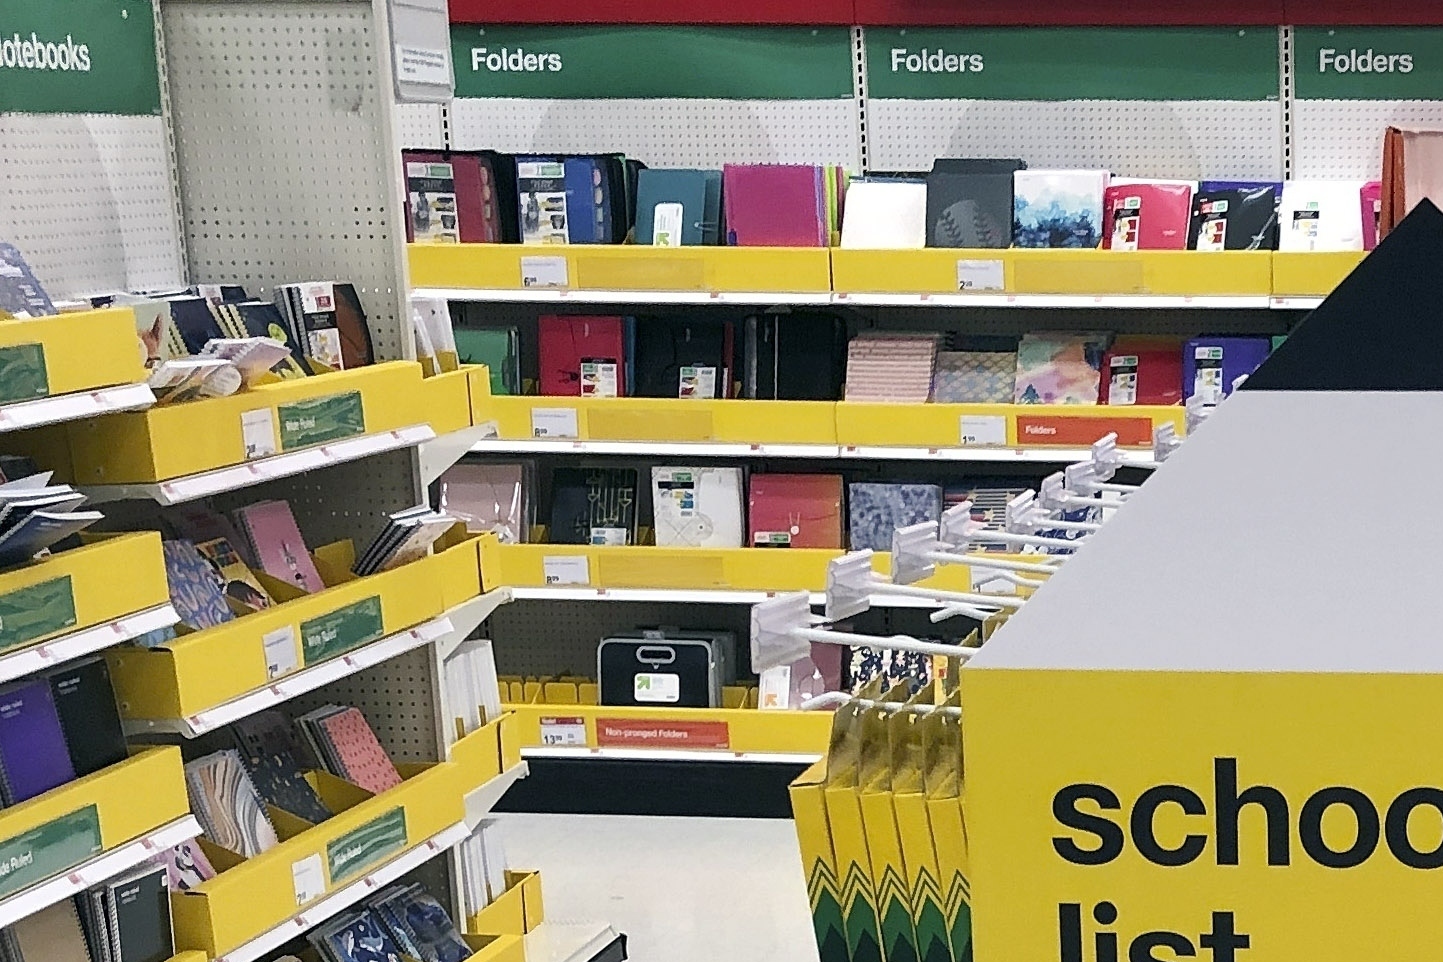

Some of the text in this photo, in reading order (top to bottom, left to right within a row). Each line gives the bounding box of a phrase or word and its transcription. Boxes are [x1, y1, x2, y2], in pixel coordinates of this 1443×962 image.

[0, 32, 91, 71] otebooks
[471, 48, 562, 71] Folders
[891, 48, 984, 72] Folders
[1319, 48, 1414, 73] Folders
